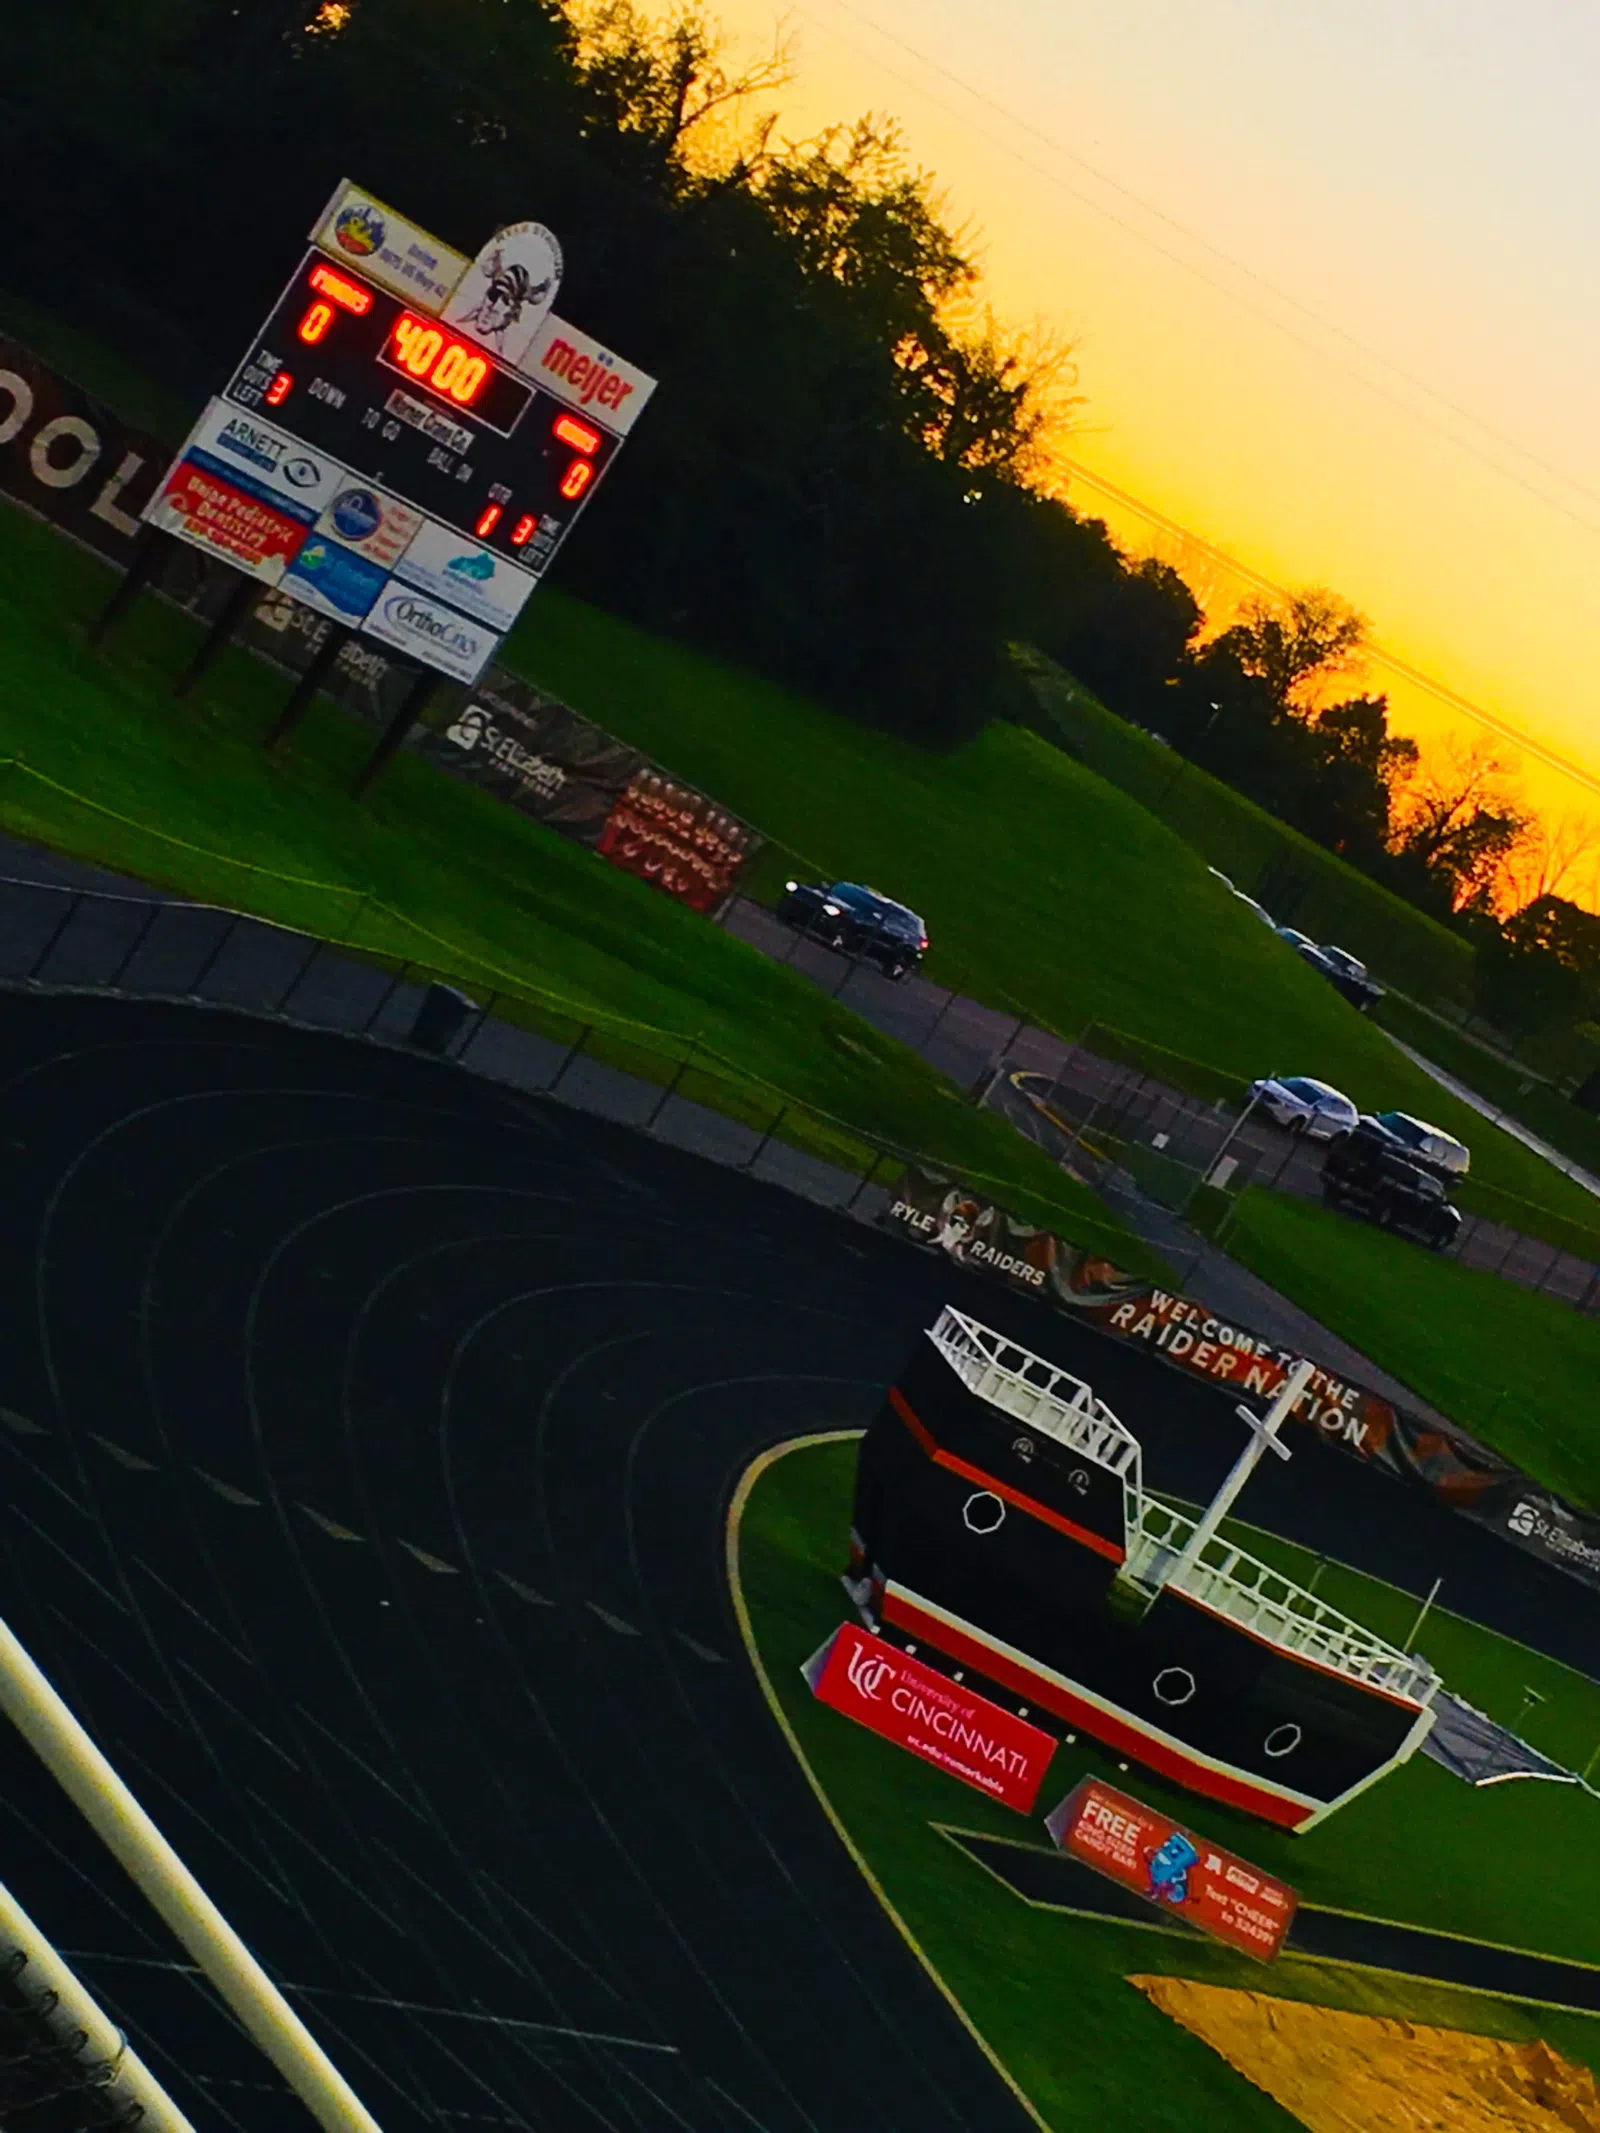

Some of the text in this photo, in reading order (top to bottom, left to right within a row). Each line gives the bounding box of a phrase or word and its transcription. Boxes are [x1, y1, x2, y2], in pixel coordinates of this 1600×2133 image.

[301, 305, 332, 342] 0
[243, 364, 274, 391] OUTS
[267, 375, 290, 405] 3
[541, 337, 633, 412] meijer
[232, 380, 263, 408] LEFT
[308, 377, 347, 410] DOWN
[223, 417, 287, 463] ARNETT
[563, 462, 590, 497] 0
[187, 475, 227, 507] Union
[226, 493, 294, 544] Pediatric
[196, 500, 268, 548] Dentistry
[513, 518, 533, 544] 3
[891, 1202, 935, 1234] RYLE
[971, 1238, 1046, 1288] RAIDERS
[1150, 1290, 1272, 1362] WELCOME
[1312, 1368, 1359, 1409] THE
[1110, 1303, 1371, 1450] RAIDER NATION
[899, 1669, 977, 1721] University of
[1081, 1800, 1141, 1844] FREE
[1074, 1829, 1111, 1855] CANDY
[1204, 1884, 1228, 1905] Text
[1220, 1911, 1234, 1924] to
